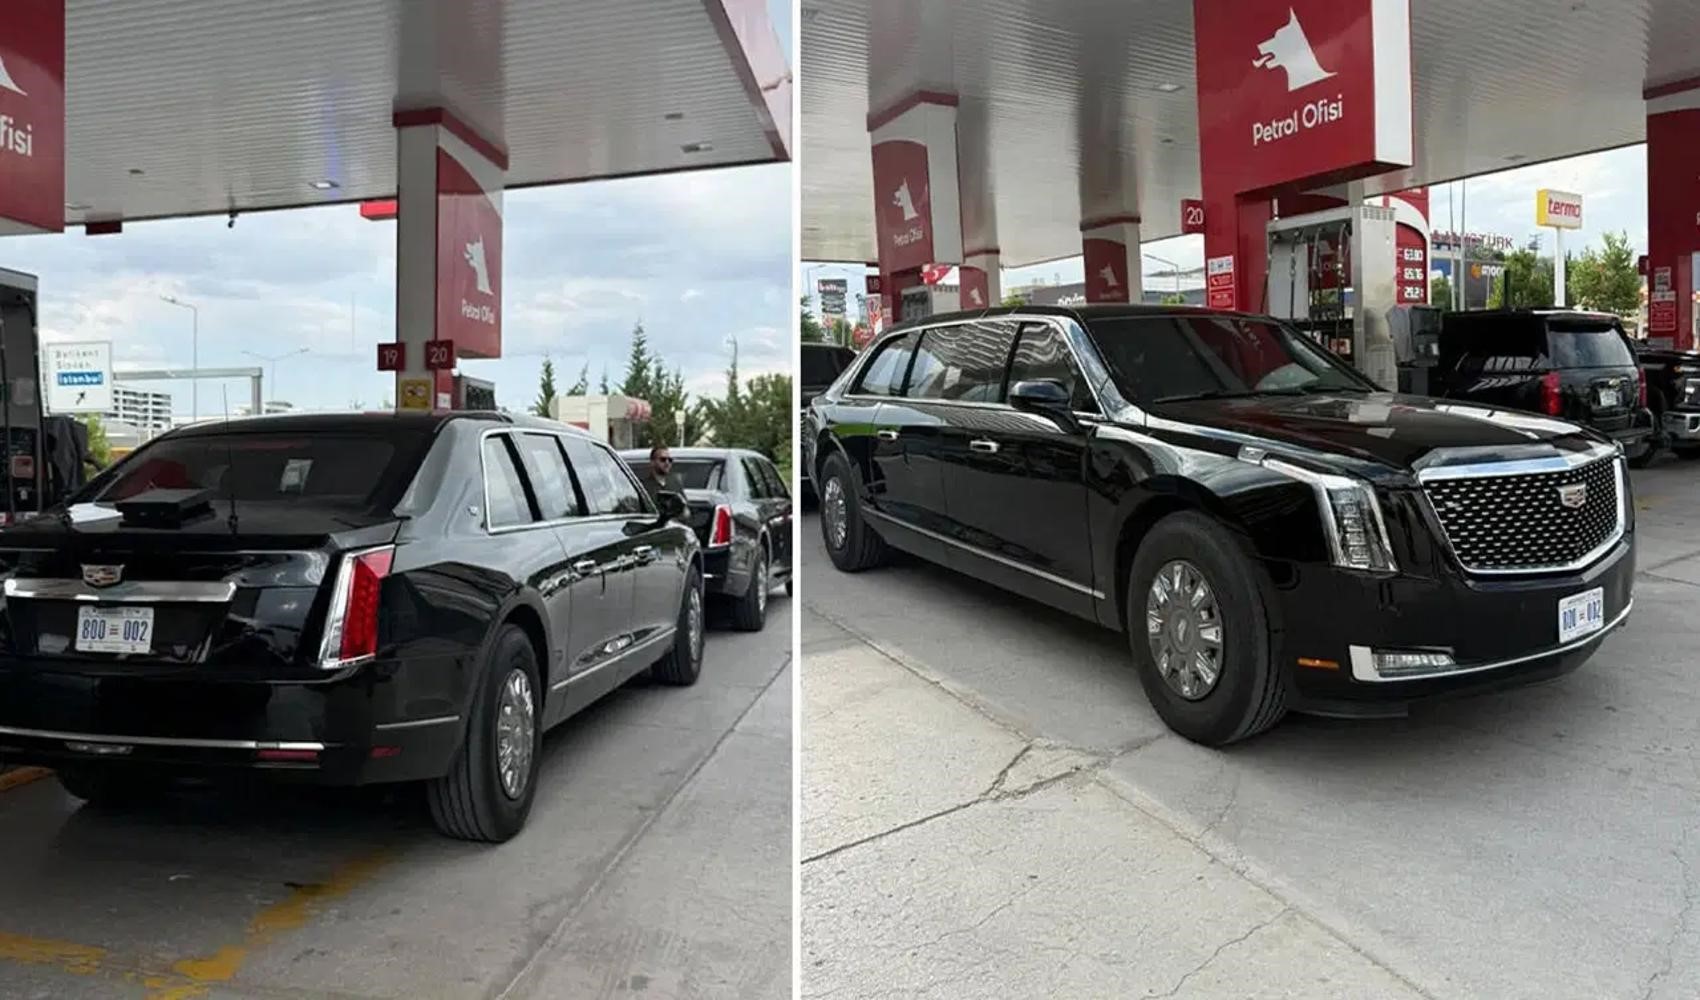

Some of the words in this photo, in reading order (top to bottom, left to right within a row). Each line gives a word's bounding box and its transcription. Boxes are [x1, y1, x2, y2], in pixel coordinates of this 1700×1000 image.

[1253, 109, 1298, 146] Petrol
[1302, 93, 1343, 128] Ofisi
[1186, 206, 1204, 225] 20
[1548, 198, 1580, 218] termo
[384, 350, 398, 366] 19
[430, 346, 448, 363] 20
[82, 619, 106, 640] 800
[123, 620, 148, 641] 002
